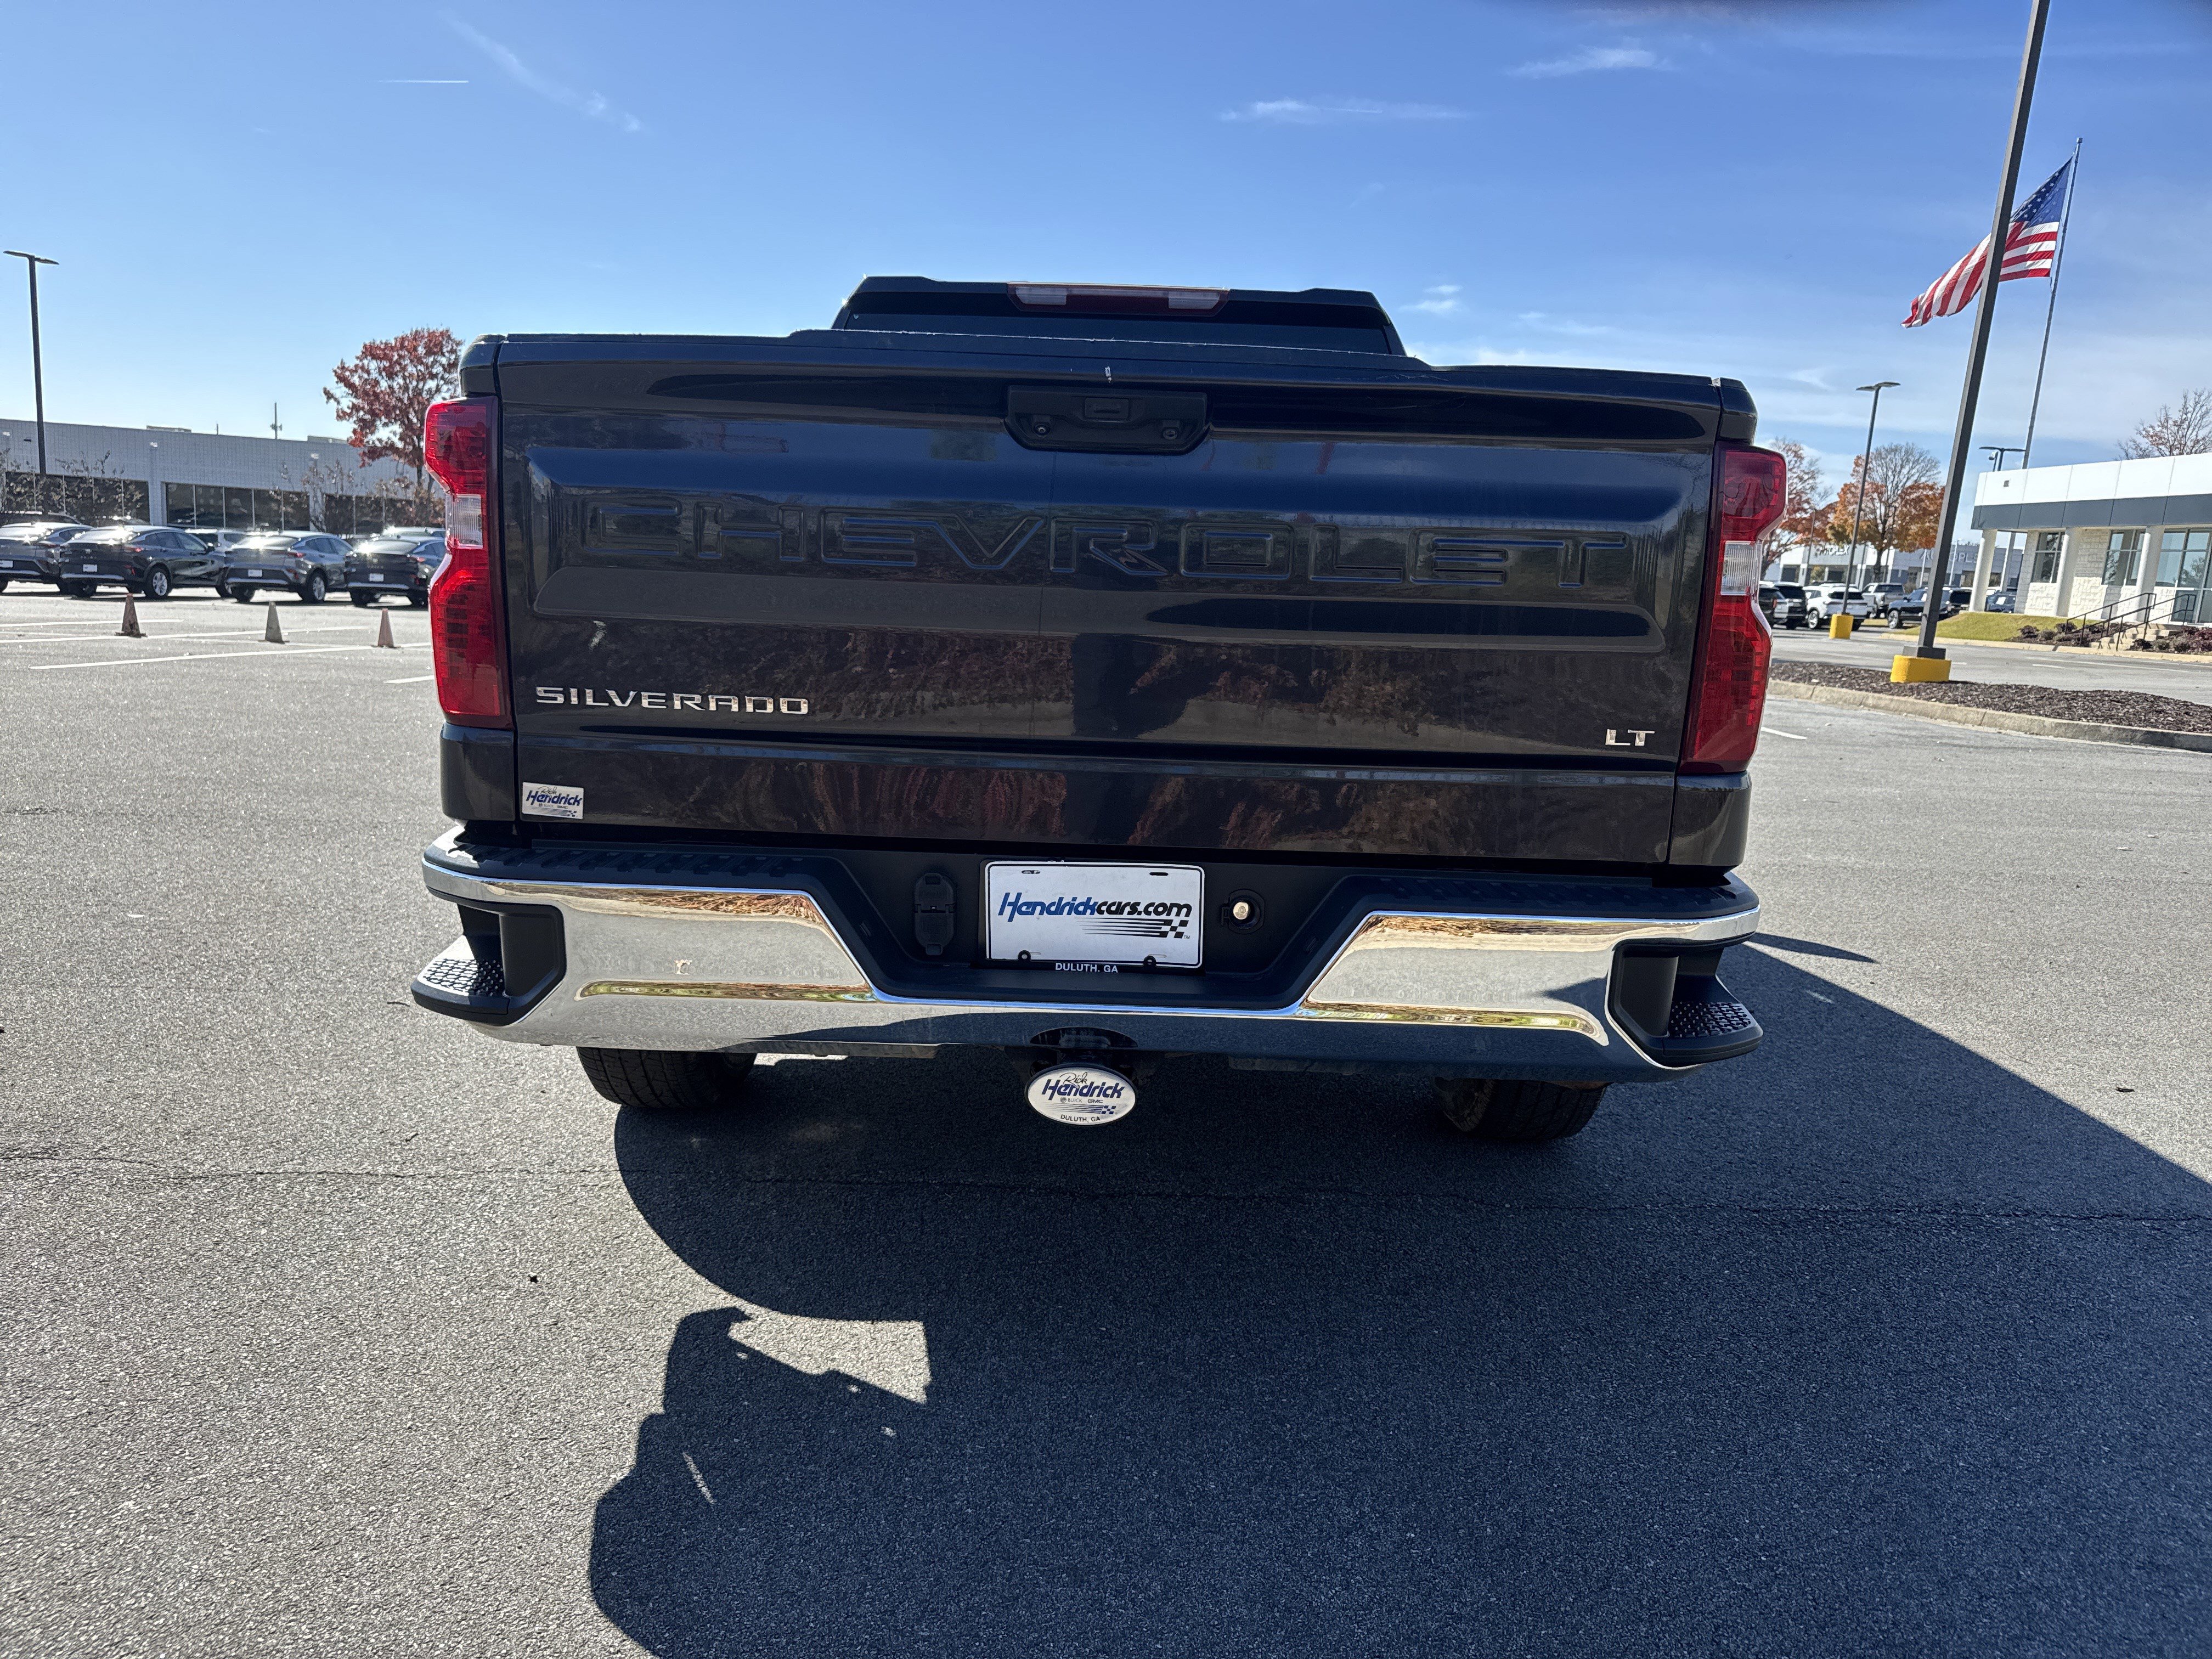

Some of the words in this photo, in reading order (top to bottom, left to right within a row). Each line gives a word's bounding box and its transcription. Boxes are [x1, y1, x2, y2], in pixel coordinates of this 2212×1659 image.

[580, 496, 1628, 590] CHEVROLET
[536, 686, 809, 714] SILVERADO
[1605, 729, 1655, 746] LT
[526, 790, 583, 806] Hendrick
[538, 786, 557, 797] Rick
[997, 891, 1193, 923] Hendrickcars.com
[1103, 964, 1119, 973] GA
[1059, 1071, 1088, 1088] Rick
[1041, 1079, 1125, 1101] Hendrick
[1060, 1114, 1089, 1124] DULUTH,
